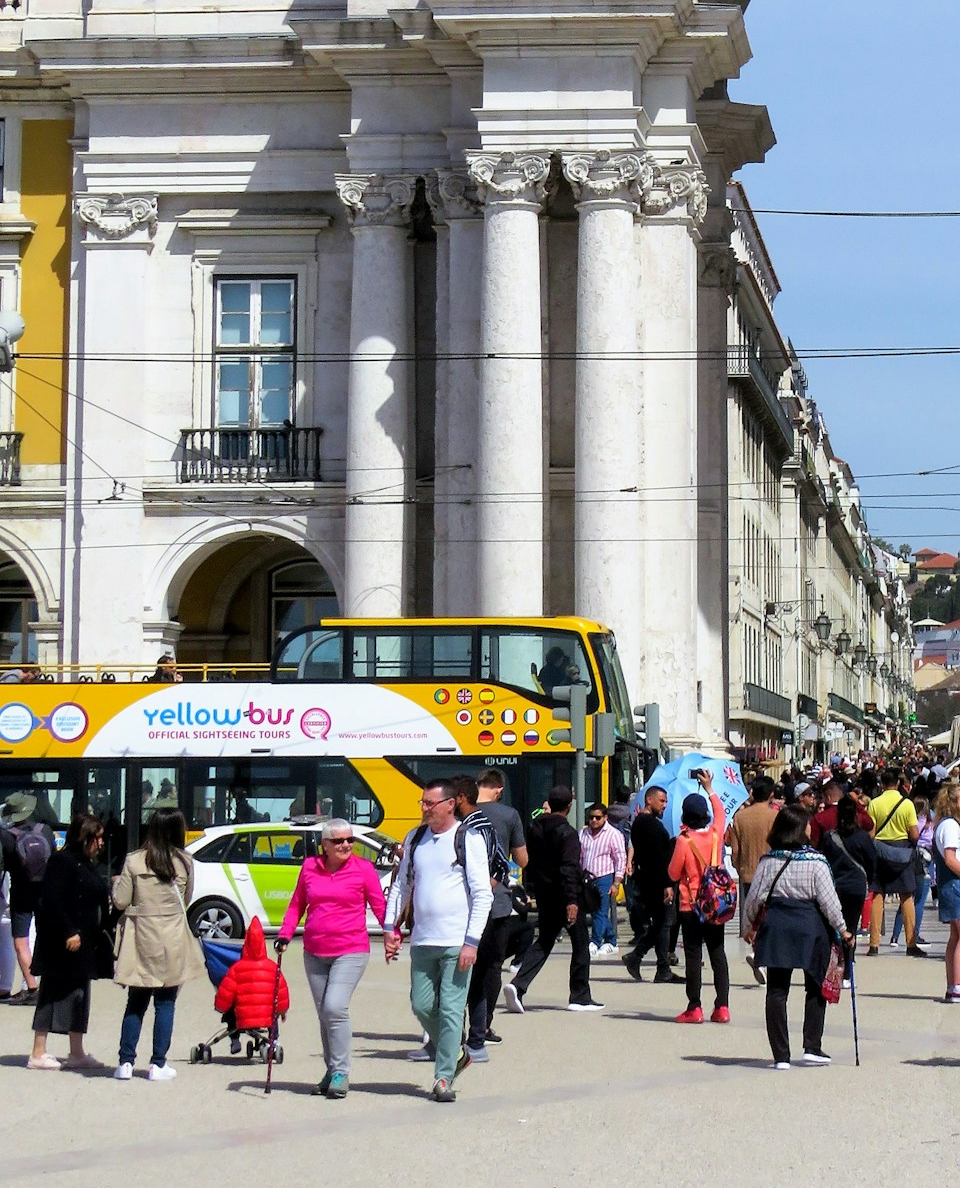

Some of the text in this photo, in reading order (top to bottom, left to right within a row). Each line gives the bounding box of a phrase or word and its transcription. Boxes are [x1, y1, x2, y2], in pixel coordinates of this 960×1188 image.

[148, 730, 291, 740] OFFICIAL SIGHTSEEING TOURS
[338, 732, 428, 740] www.yellowbustours.com
[724, 798, 738, 818] OUR
